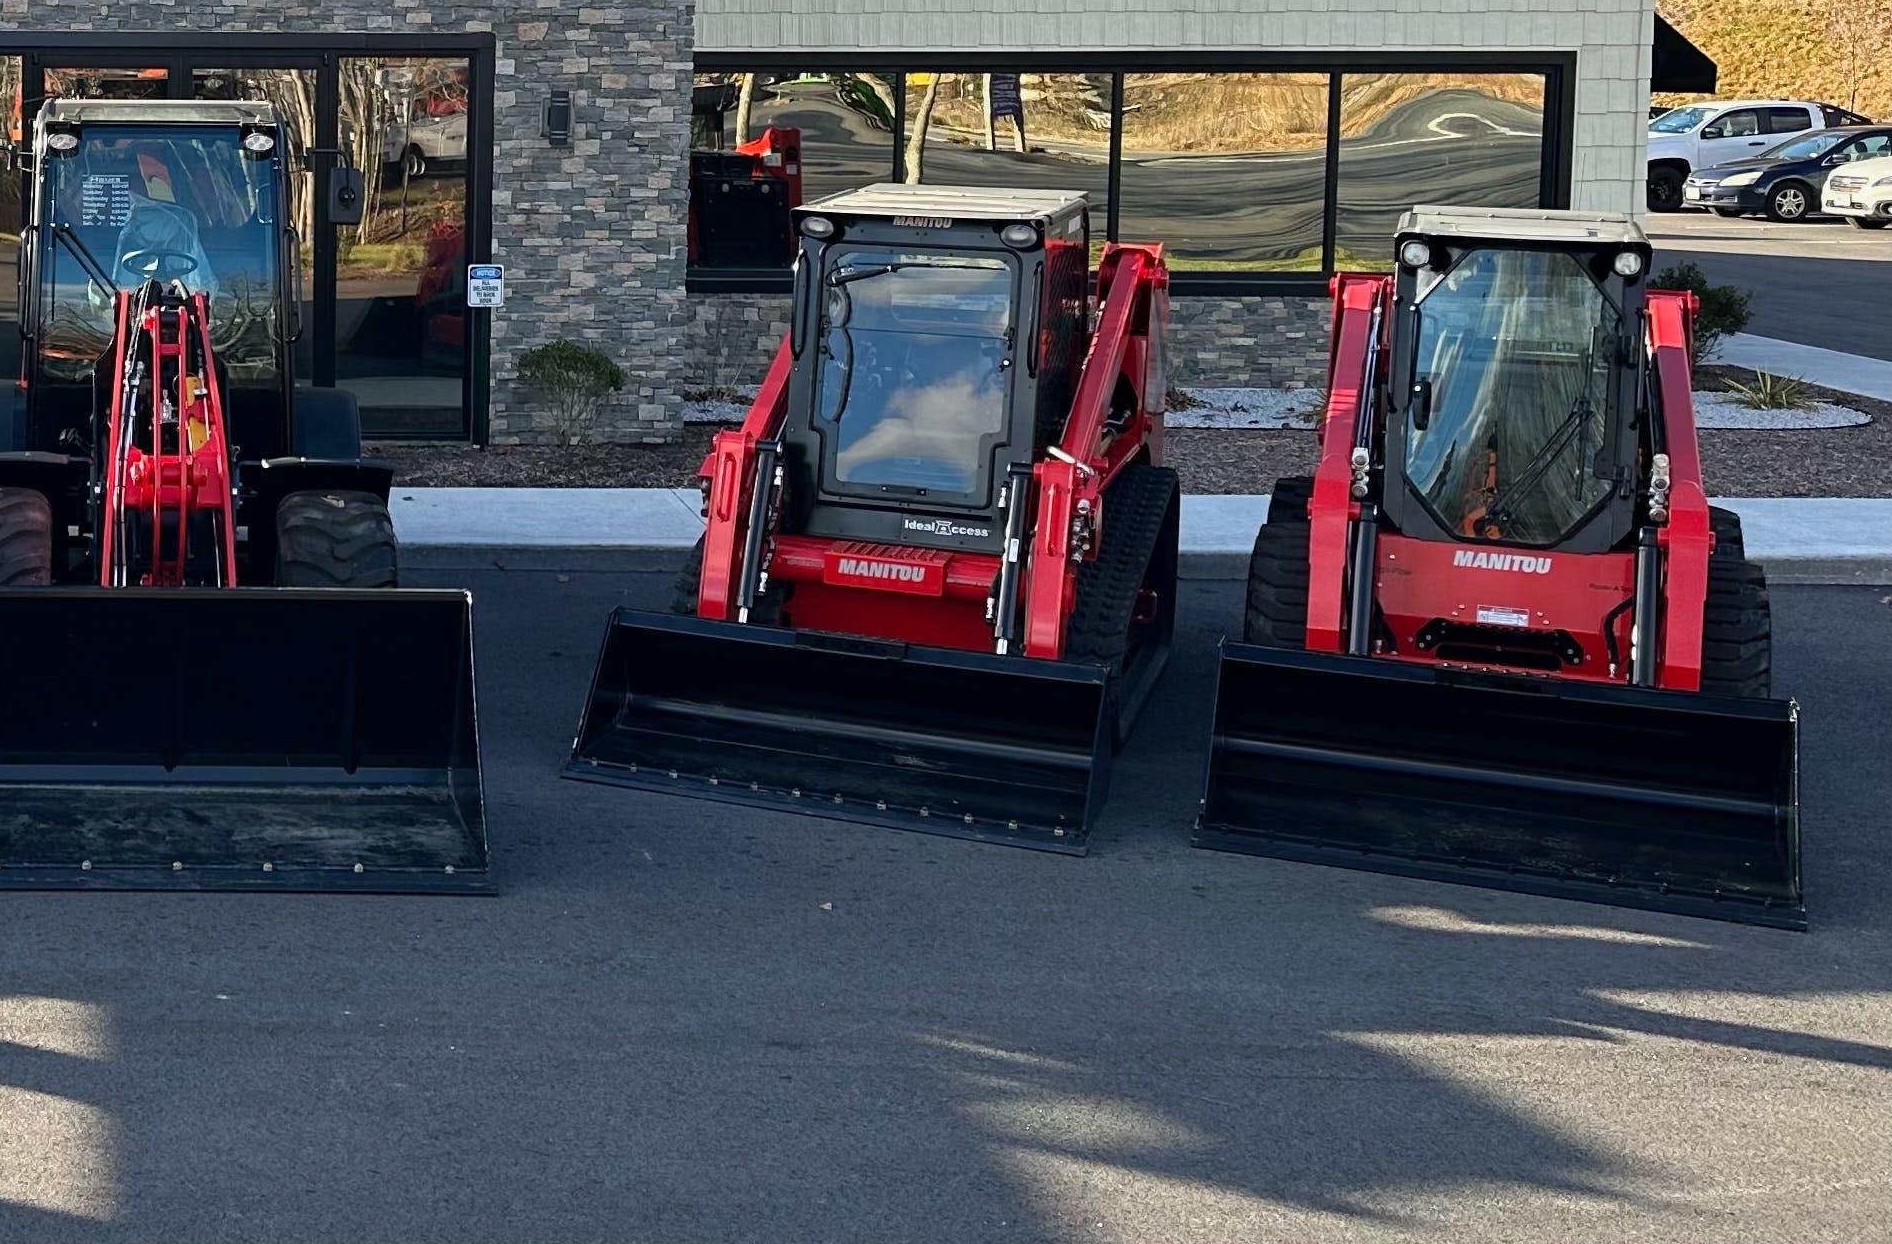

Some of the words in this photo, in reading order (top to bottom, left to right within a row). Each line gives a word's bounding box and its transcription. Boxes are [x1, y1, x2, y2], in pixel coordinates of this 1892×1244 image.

[892, 215, 953, 229] MANITOU
[837, 558, 926, 583] MANITOU
[1453, 550, 1552, 575] MANITOU
